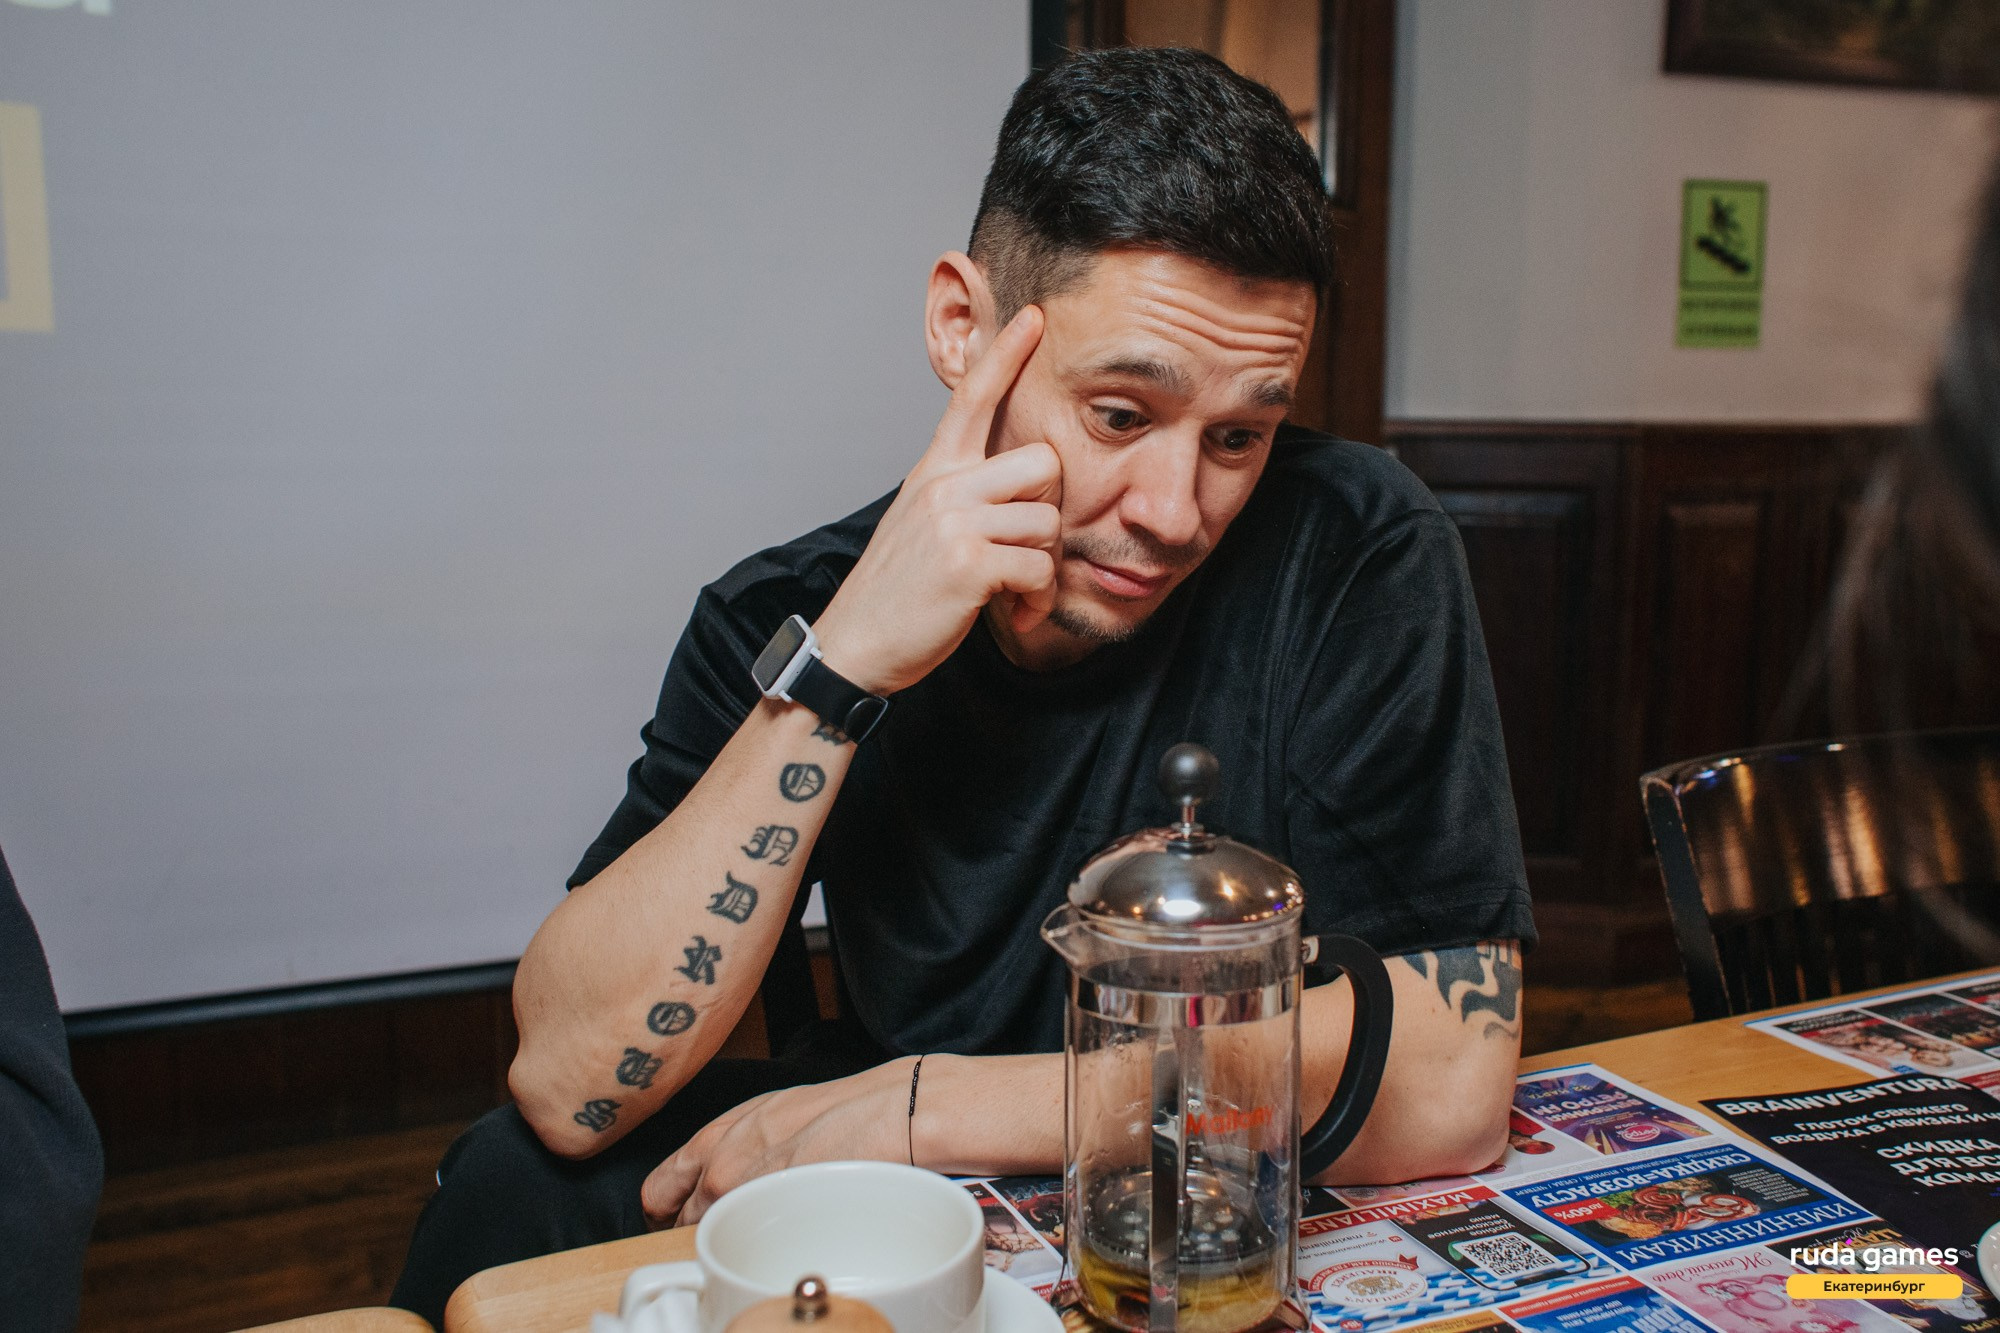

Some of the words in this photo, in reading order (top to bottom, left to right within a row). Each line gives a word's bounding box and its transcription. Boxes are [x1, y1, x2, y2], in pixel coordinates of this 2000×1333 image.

[1528, 1089, 1569, 1100] МАРТА
[1561, 1092, 1629, 1110] РЕТРО
[1717, 1079, 1972, 1116] BRAINVENTURA
[1545, 1099, 1644, 1122] ВЕЧЕРИНКА
[1794, 1114, 1876, 1131] ГЛОТОК
[1873, 1104, 1968, 1120] СВЕЖЕГО
[1770, 1128, 1870, 1145] ВОЗДУХА
[1866, 1123, 1886, 1133] В
[1883, 1114, 1970, 1128] КВИЗАХ
[1965, 1112, 1987, 1122] И
[1876, 1139, 2000, 1159] СКИДКА
[1586, 1169, 1619, 1180] ВТОРНИК
[1890, 1157, 1962, 1176] ДЛЯ
[1552, 1177, 1577, 1188] СРЕДА
[1913, 1172, 2000, 1187] КОМА
[1515, 1184, 1548, 1196] ЧЕТВЕРГ
[1299, 1192, 1474, 1235] MAXIMILIANS
[1553, 1206, 1592, 1222] 60%
[1616, 1203, 1858, 1264] ИМЕНИННИКАМ
[1685, 1252, 1772, 1276] Женский
[1652, 1269, 1691, 1282] день
